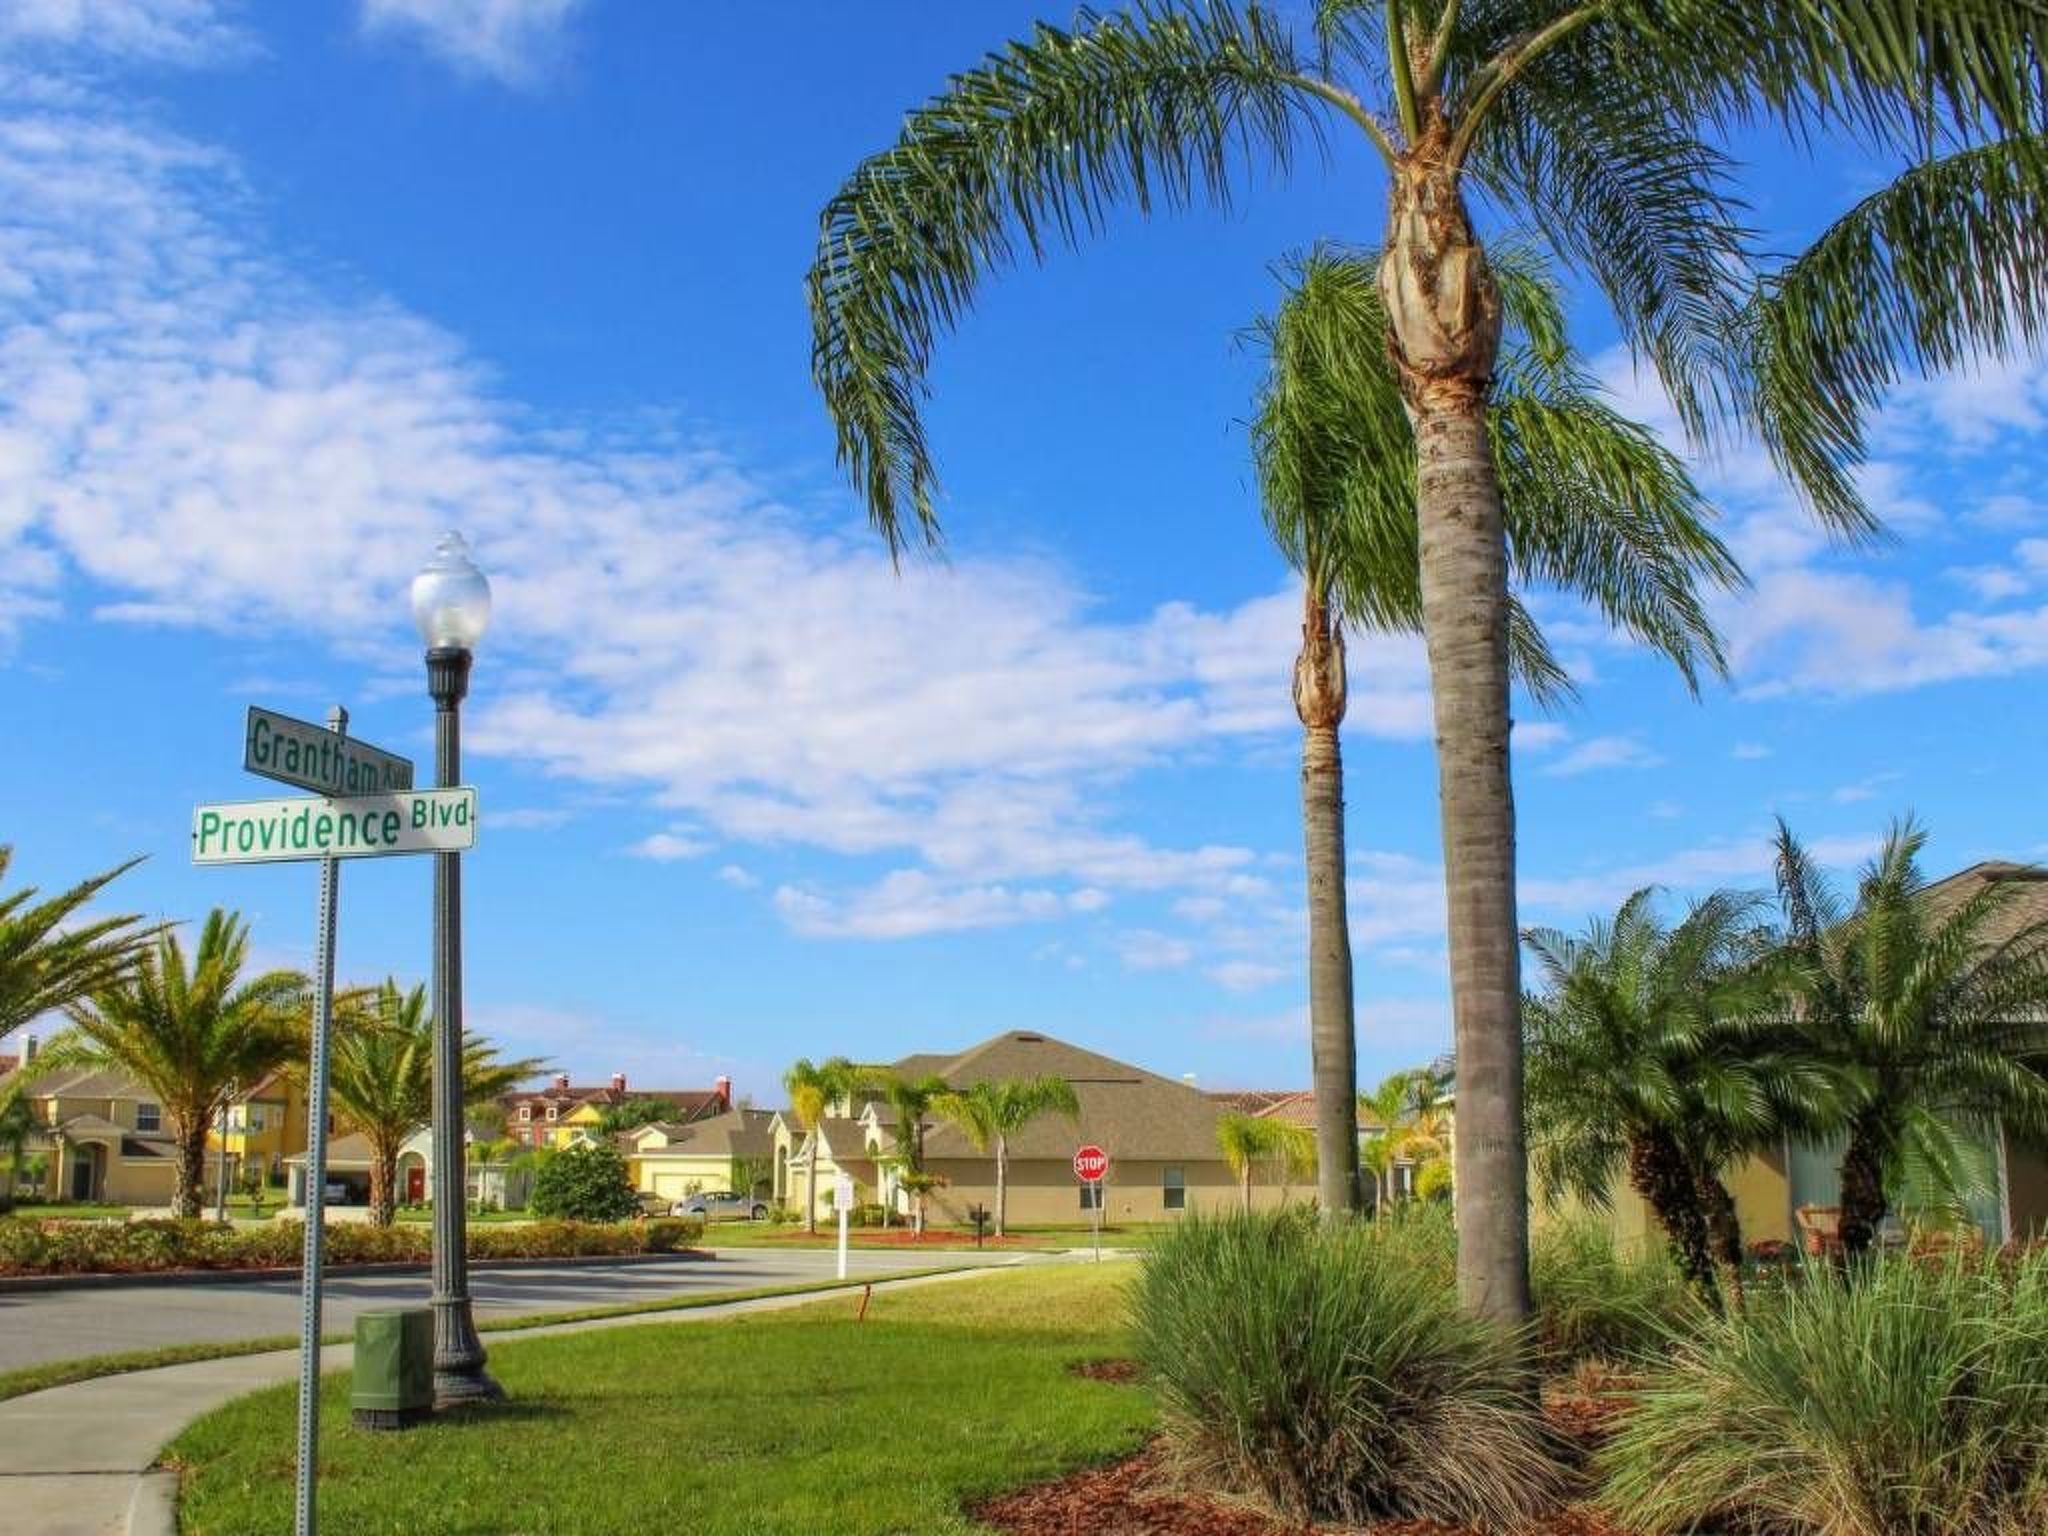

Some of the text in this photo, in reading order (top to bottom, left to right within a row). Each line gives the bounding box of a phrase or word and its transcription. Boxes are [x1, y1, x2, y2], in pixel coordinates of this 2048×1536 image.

[253, 718, 378, 794] Grantham
[199, 798, 469, 854] Providence Blvd
[1077, 1156, 1105, 1171] STOP
